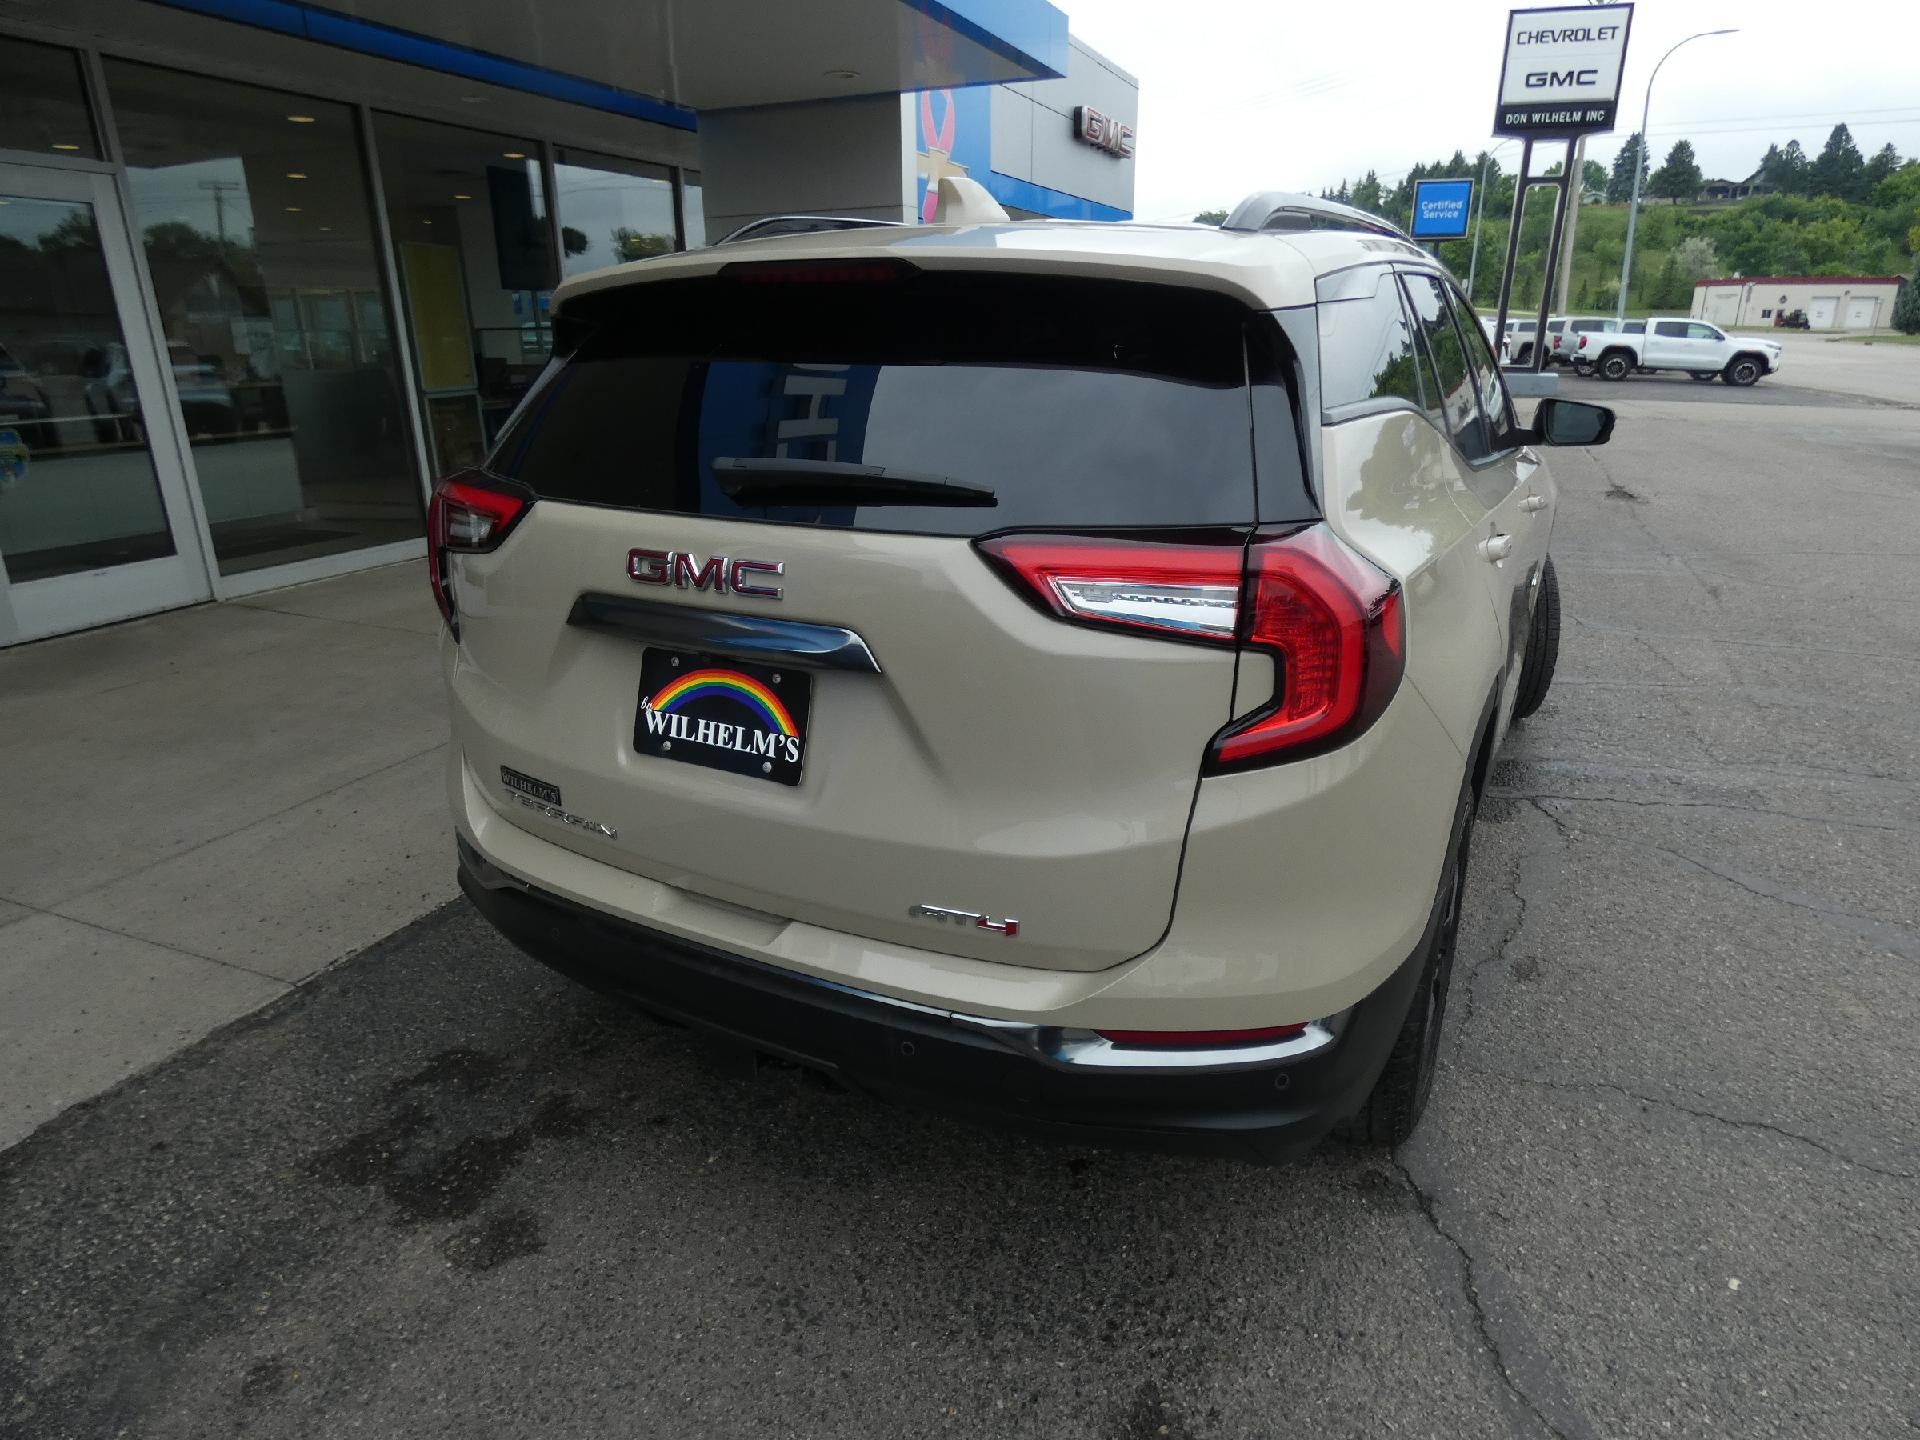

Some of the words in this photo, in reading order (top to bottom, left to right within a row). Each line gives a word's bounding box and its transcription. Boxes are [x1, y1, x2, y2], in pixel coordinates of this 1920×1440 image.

[1516, 26, 1620, 46] CHEVROLET
[1525, 69, 1598, 88] GMC
[1505, 113, 1527, 125] DON
[1532, 111, 1582, 124] WILHELM
[1586, 110, 1606, 122] INC
[1080, 106, 1134, 159] GMC
[1421, 200, 1463, 210] Certified
[1423, 210, 1459, 219] Service
[626, 546, 785, 601] GMC
[645, 709, 800, 763] WILHELM'S
